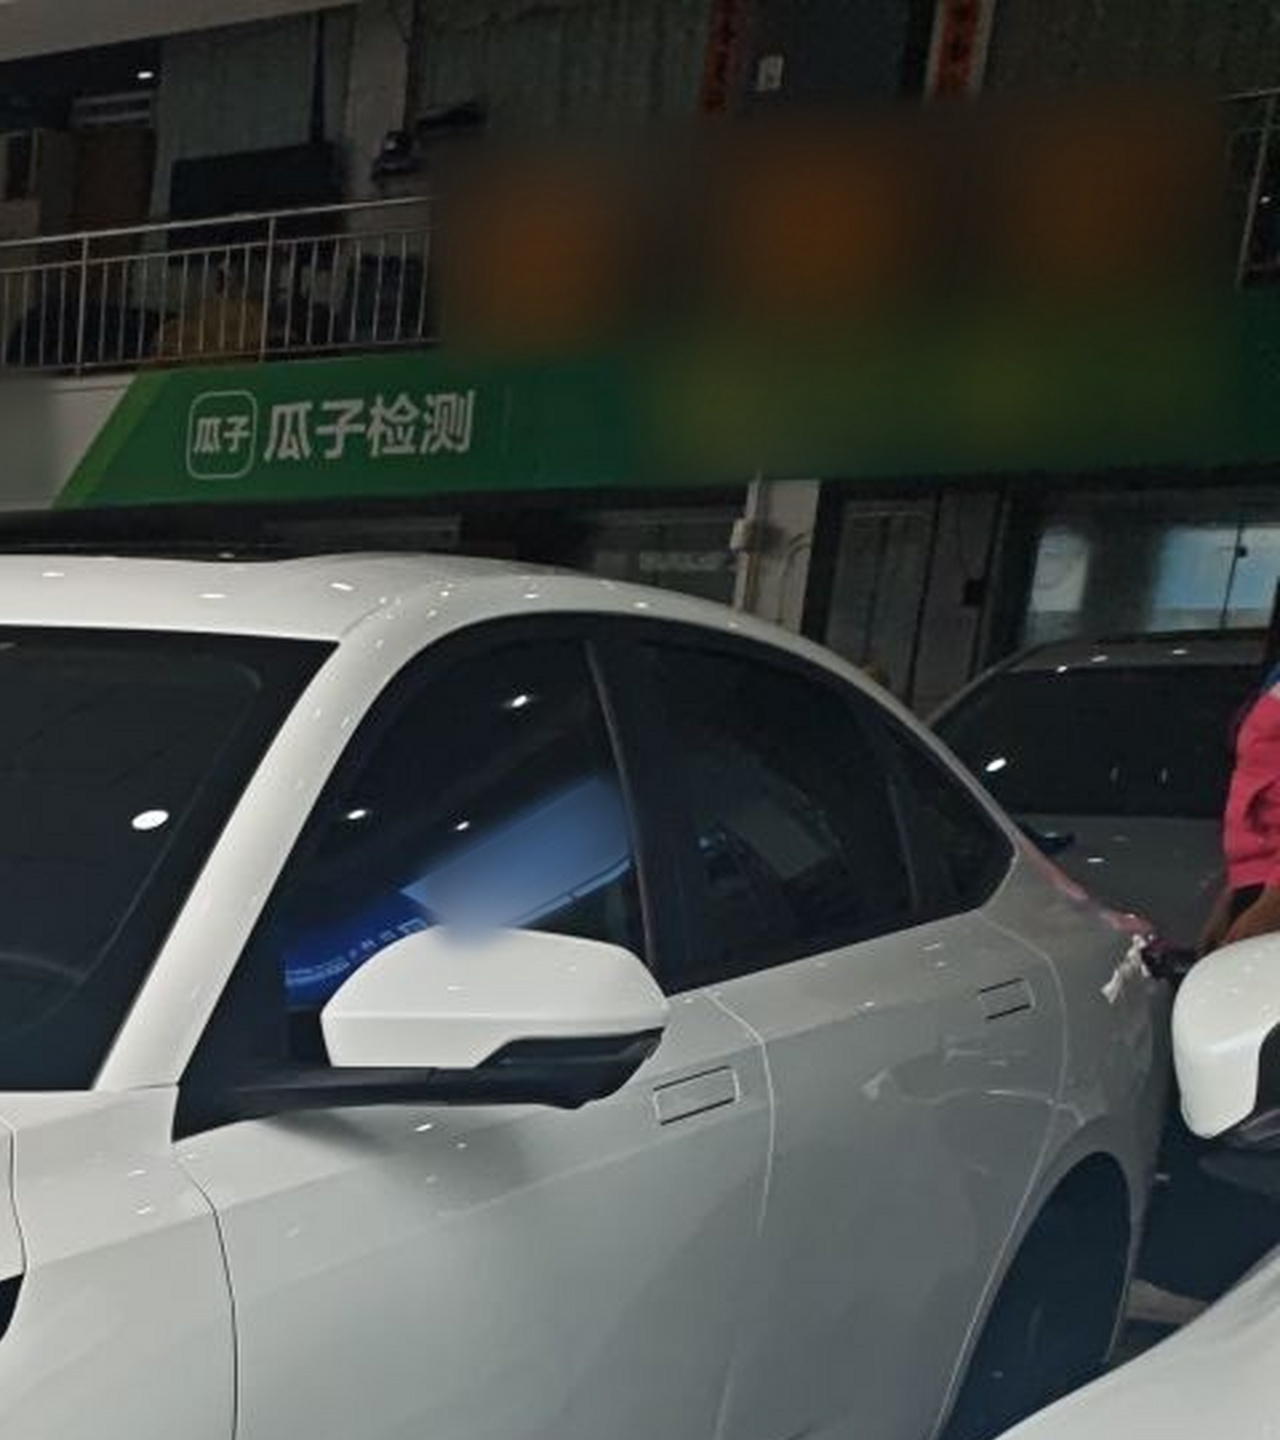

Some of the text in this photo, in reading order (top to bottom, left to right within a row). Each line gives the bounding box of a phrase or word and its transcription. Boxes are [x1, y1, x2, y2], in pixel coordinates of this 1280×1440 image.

[193, 415, 251, 453] 瓜子
[263, 390, 476, 461] 瓜子检测
